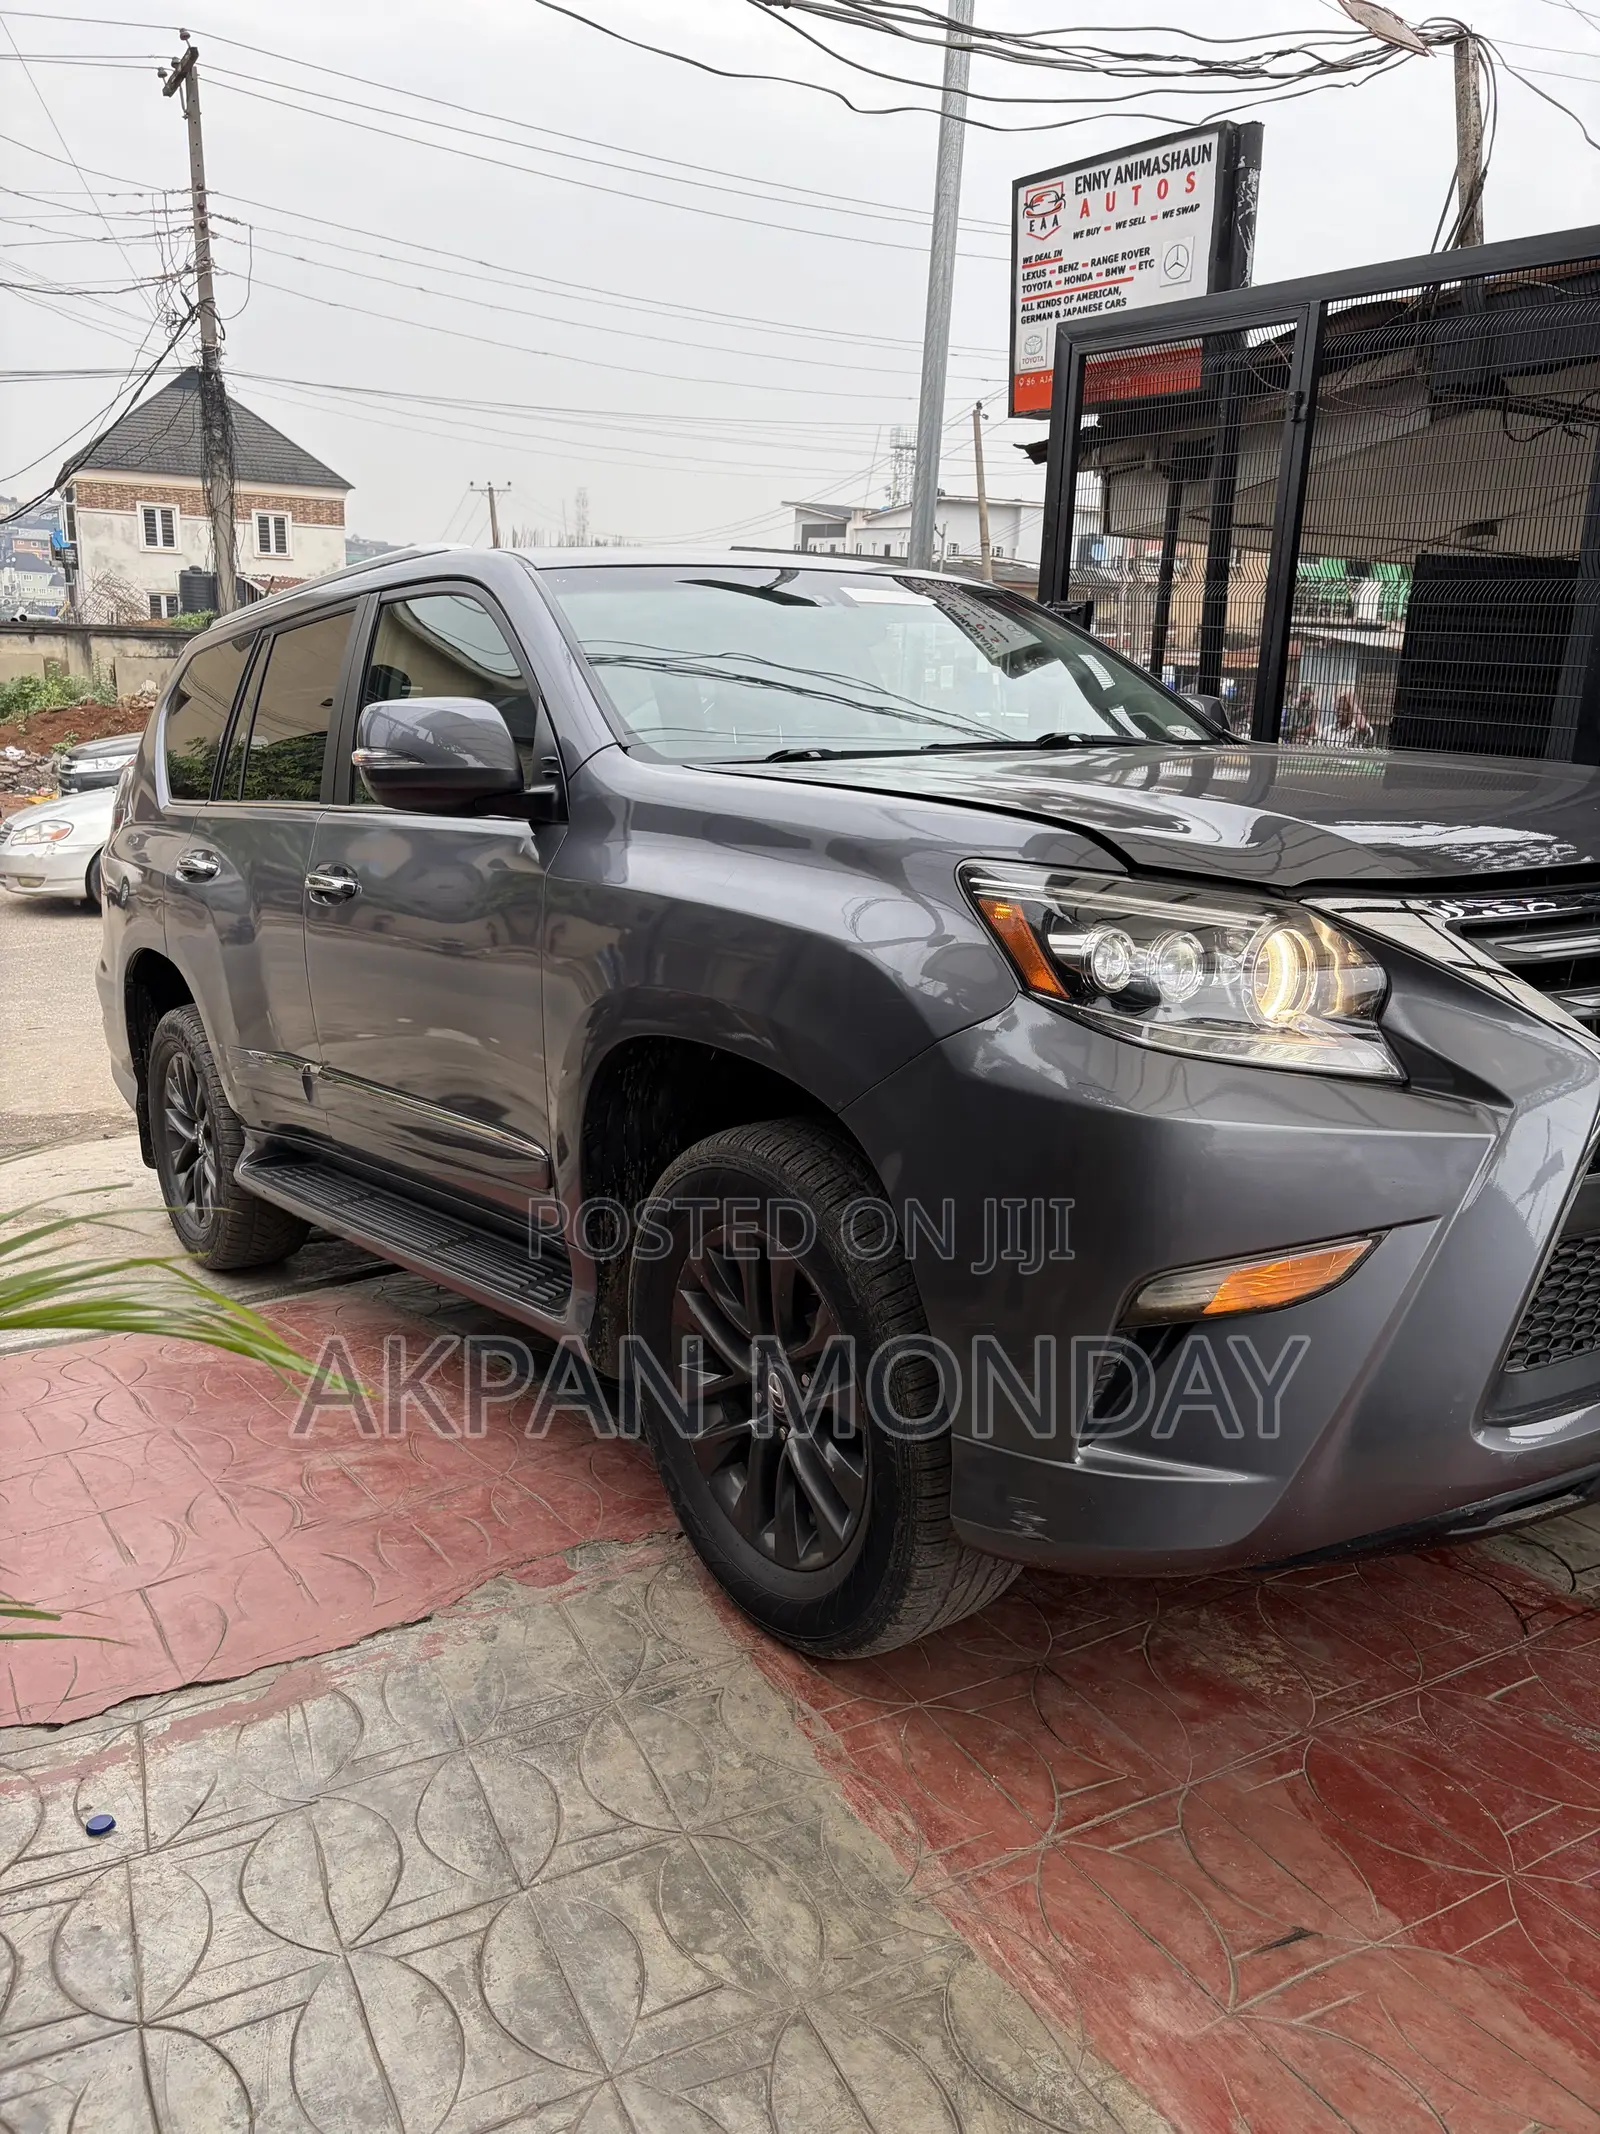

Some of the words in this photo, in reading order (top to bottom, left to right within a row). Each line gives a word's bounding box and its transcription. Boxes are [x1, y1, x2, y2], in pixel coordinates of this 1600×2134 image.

[1075, 168, 1111, 195] ENNY
[1114, 142, 1212, 185] ANIMASHAUN
[1080, 171, 1195, 219] AUTOS
[1073, 230, 1084, 239] WE
[1085, 226, 1101, 237] BUY
[1115, 220, 1127, 230] WE
[1128, 215, 1146, 227] SELL
[1162, 209, 1175, 219] WE
[1176, 203, 1200, 216] SWAP
[1022, 255, 1033, 264] WE
[1034, 252, 1052, 262] DEAL
[1053, 249, 1063, 258] IN
[1022, 269, 1047, 281] LEXUS
[1058, 262, 1079, 274] BENZ
[1090, 254, 1119, 268] RANGE
[1121, 246, 1150, 260] ROVER
[1022, 280, 1052, 293] TOYOTA
[1064, 272, 1093, 286] HONDA
[1105, 264, 1126, 277] BMW
[1138, 259, 1155, 271] ETC
[1021, 301, 1034, 312] ALL
[1036, 296, 1062, 310] KINDS
[1063, 293, 1075, 304] OF
[1076, 286, 1122, 302] AMERICAN,
[1021, 312, 1053, 325] GERMAN
[1055, 310, 1061, 319] &
[1062, 301, 1103, 318] JAPANESE
[1105, 297, 1127, 309] CARS
[1022, 356, 1044, 365] TOYOTA
